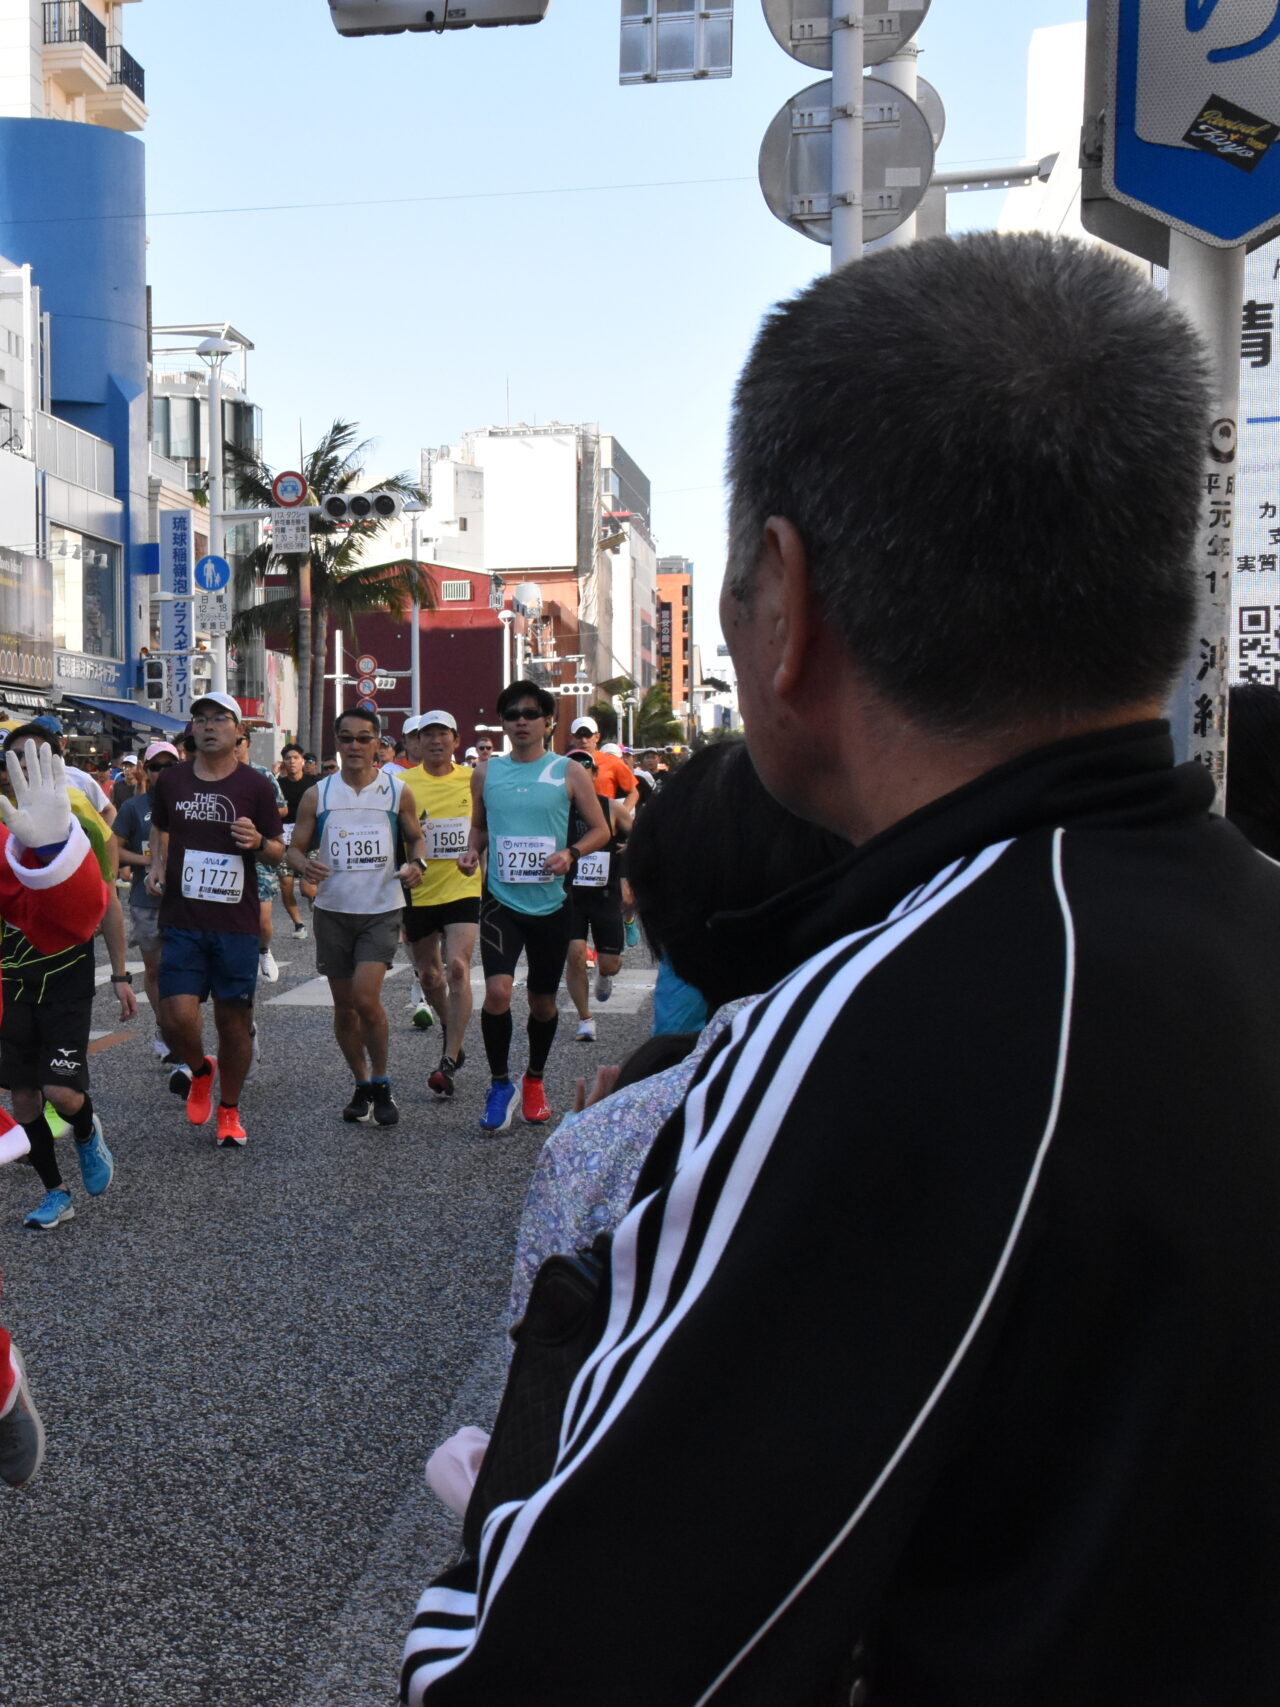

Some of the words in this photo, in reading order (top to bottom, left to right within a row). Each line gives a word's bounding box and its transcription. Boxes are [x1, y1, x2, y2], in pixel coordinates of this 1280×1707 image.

[194, 793, 216, 803] THE
[176, 801, 215, 812] NORTH
[185, 810, 215, 821] FACE
[433, 831, 465, 846] 1505
[331, 841, 339, 857] C
[345, 840, 380, 857] 1361
[203, 857, 220, 865] ANA
[508, 851, 547, 868] 2795
[581, 862, 603, 875] 674
[184, 866, 194, 882] C
[200, 868, 238, 888] 1777
[50, 1058, 81, 1070] NXT
